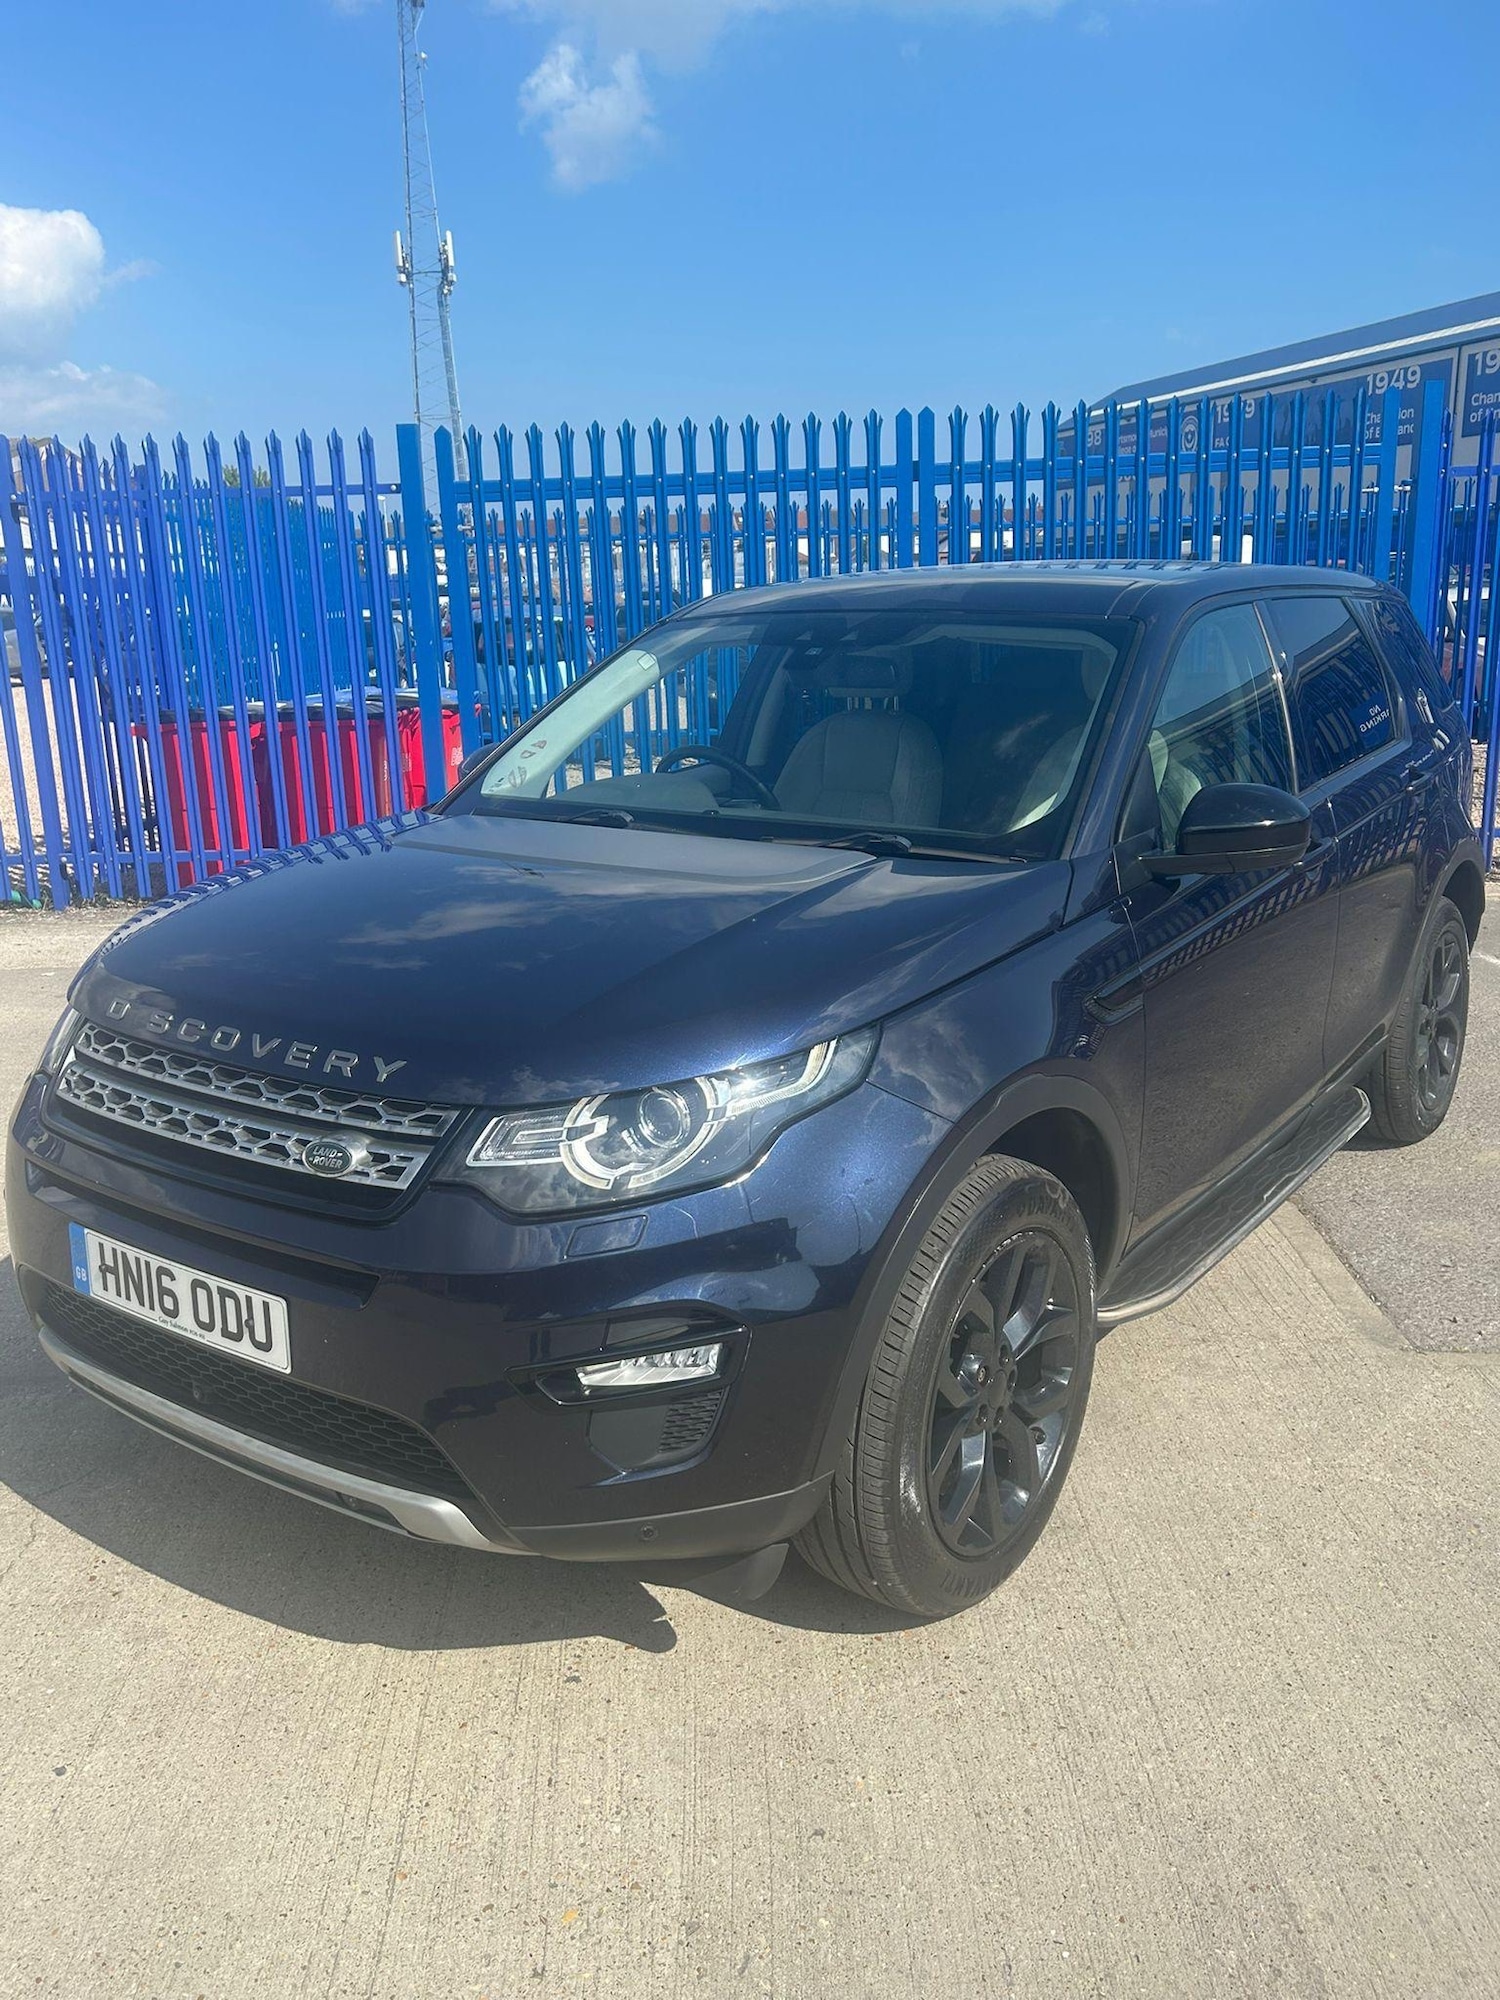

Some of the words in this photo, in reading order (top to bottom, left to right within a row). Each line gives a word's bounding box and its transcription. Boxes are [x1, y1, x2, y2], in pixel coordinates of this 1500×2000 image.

[1366, 365, 1421, 396] 1949
[1215, 399, 1256, 424] 199
[74, 1265, 88, 1282] GB
[97, 1241, 180, 1320] HN16
[190, 1277, 273, 1353] ODU
